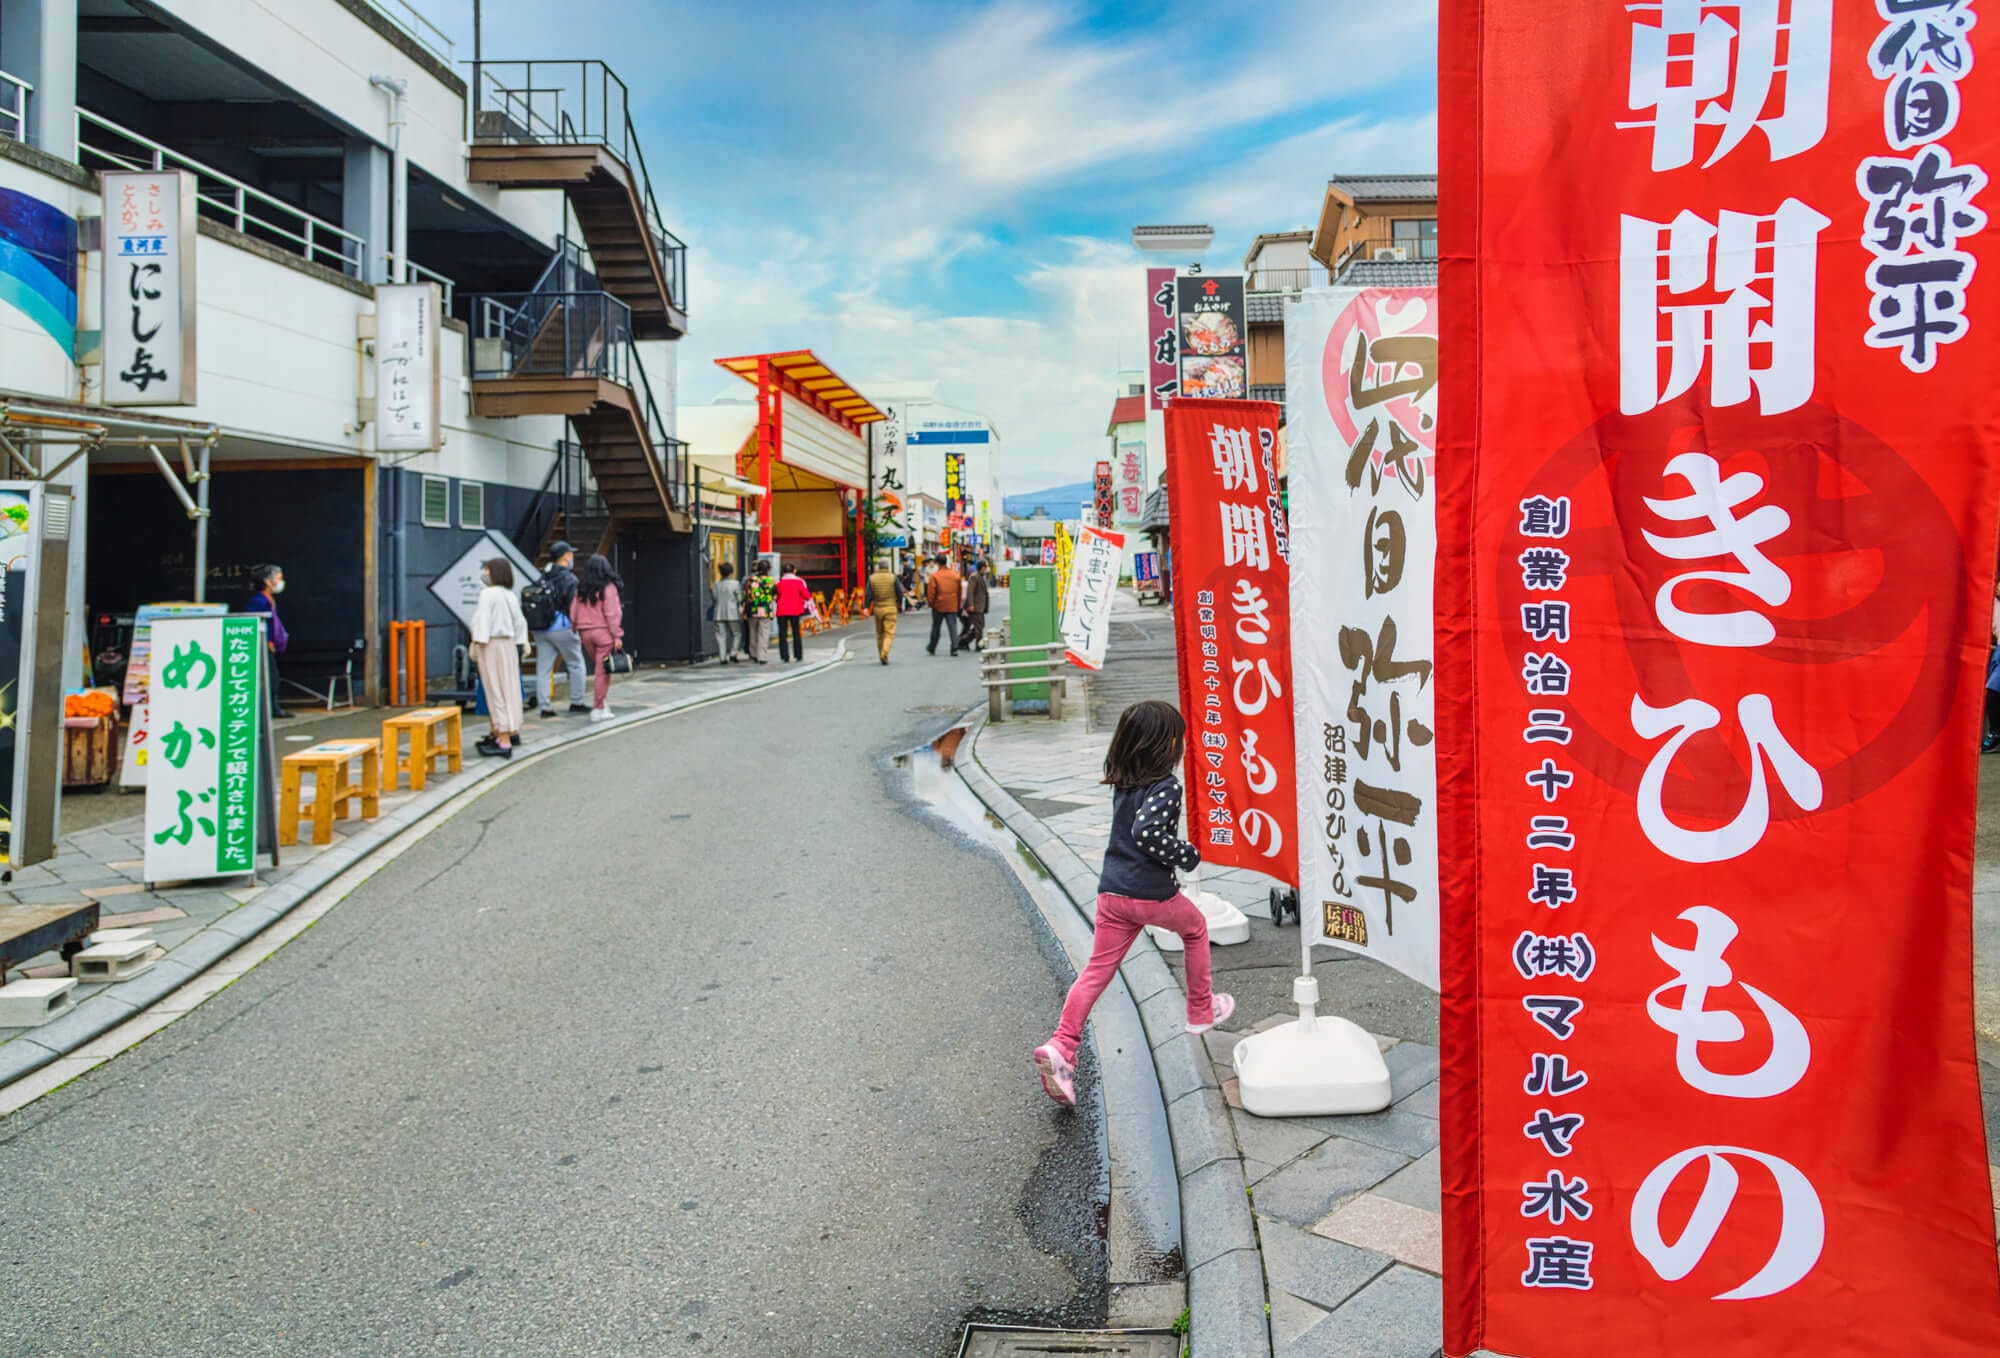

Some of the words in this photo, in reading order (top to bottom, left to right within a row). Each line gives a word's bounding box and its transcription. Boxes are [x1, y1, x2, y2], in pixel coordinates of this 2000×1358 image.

[119, 262, 168, 392] にし与
[1862, 0, 1984, 368] 代目弥平
[1121, 450, 1140, 514] 寿司
[153, 639, 217, 845] めかぶ
[1208, 423, 1283, 858] 朝開きひもの
[1615, 0, 1833, 1301] 朝開きひもの
